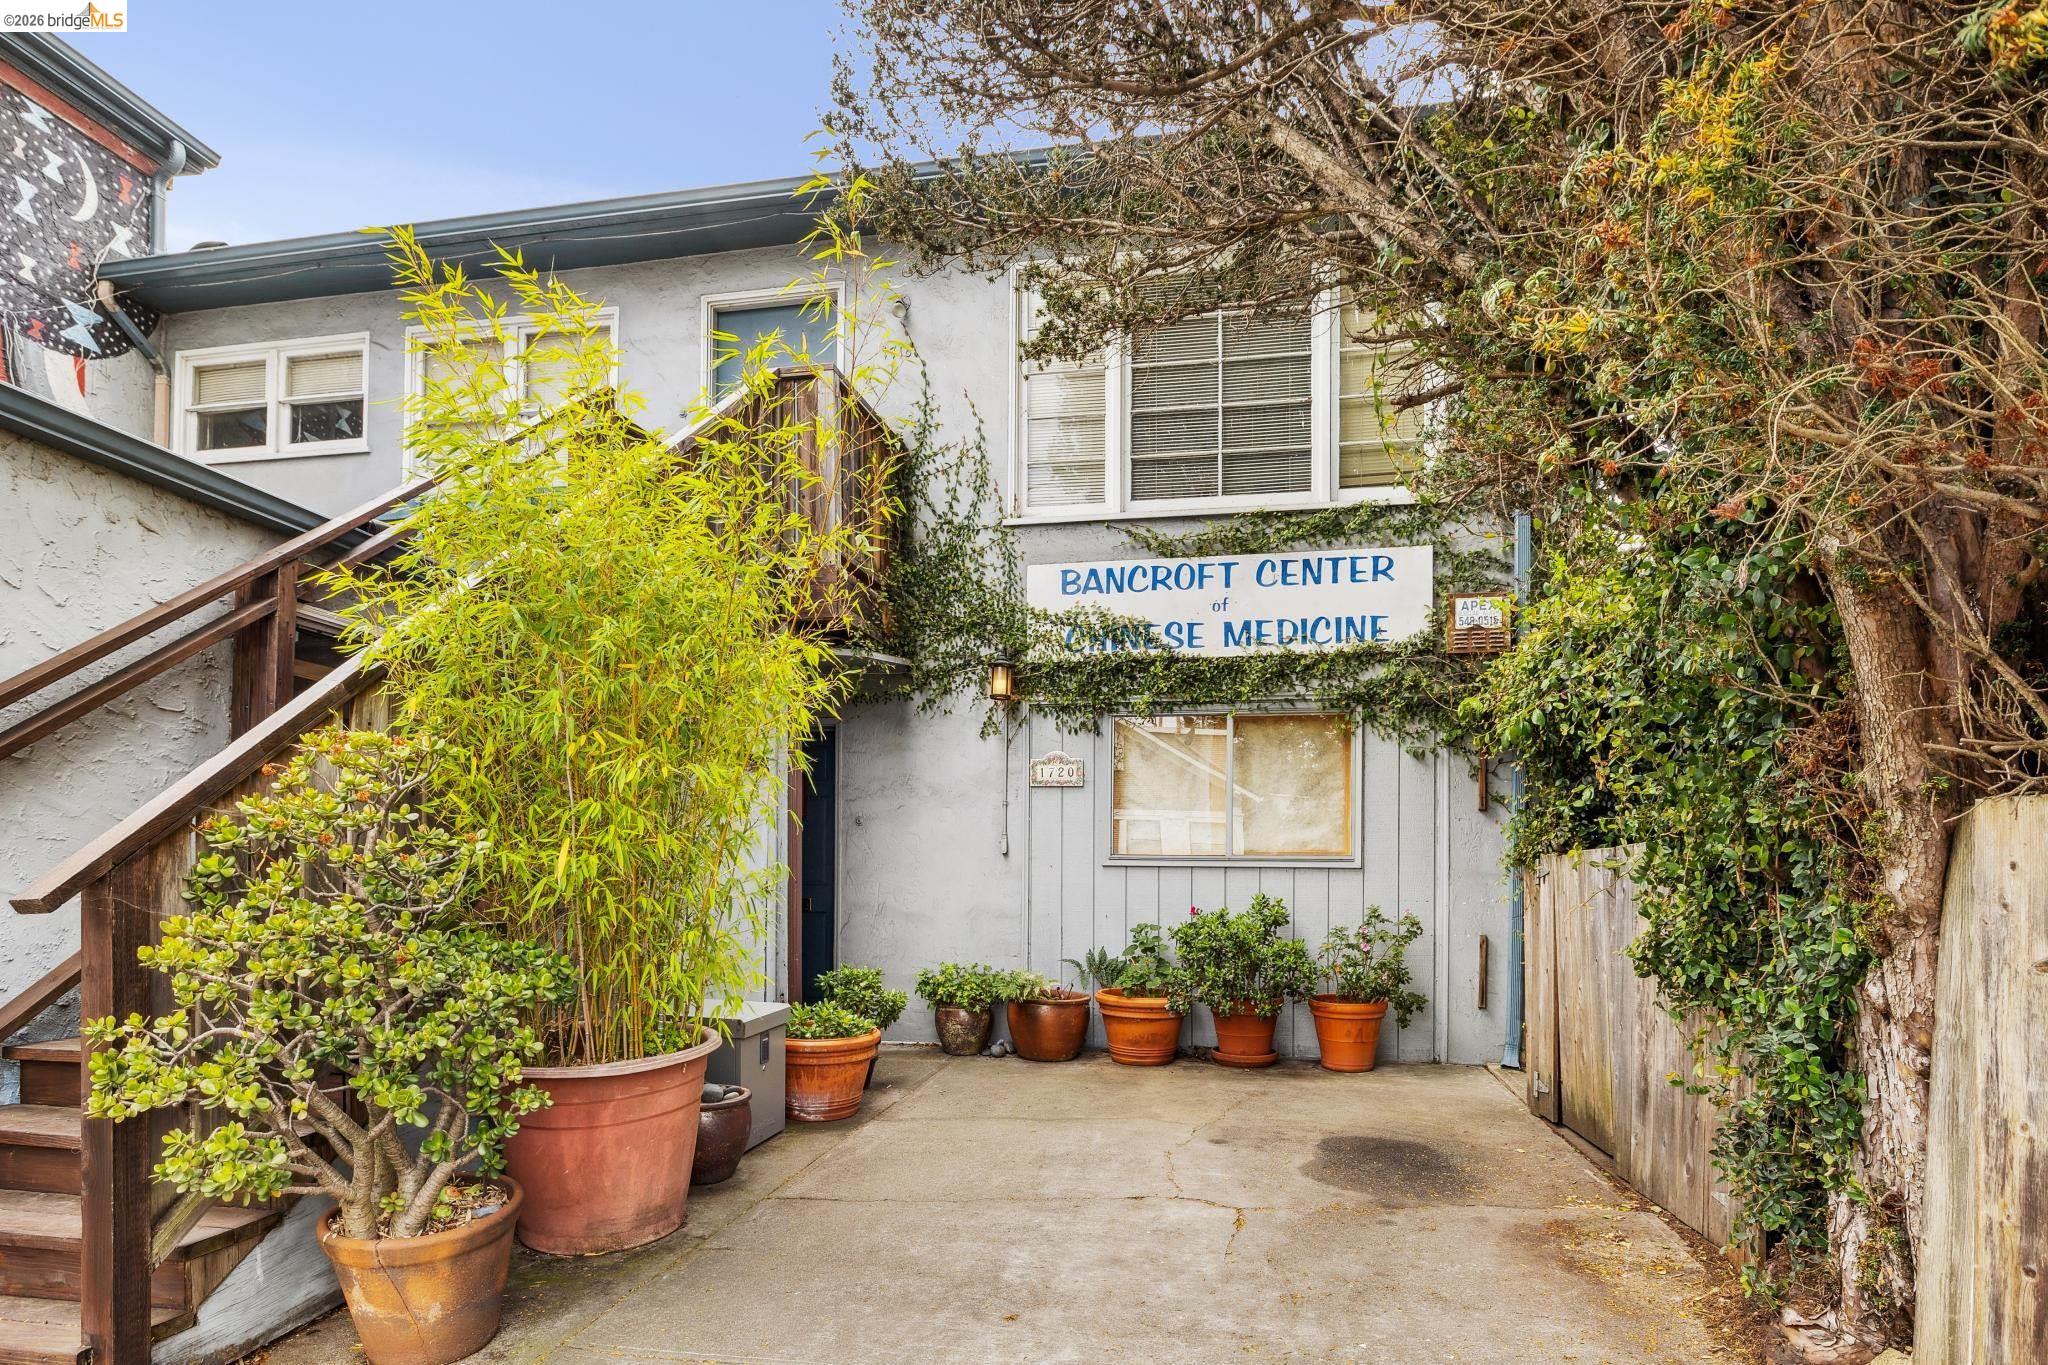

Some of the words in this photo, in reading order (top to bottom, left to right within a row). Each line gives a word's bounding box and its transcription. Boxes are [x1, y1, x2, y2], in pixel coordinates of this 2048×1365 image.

[1060, 562, 1240, 596] BANCROFT
[1255, 555, 1396, 588] CENTER
[1212, 597, 1229, 612] of
[1223, 615, 1390, 648] MEDICINE
[1040, 766, 1075, 778] 1720
